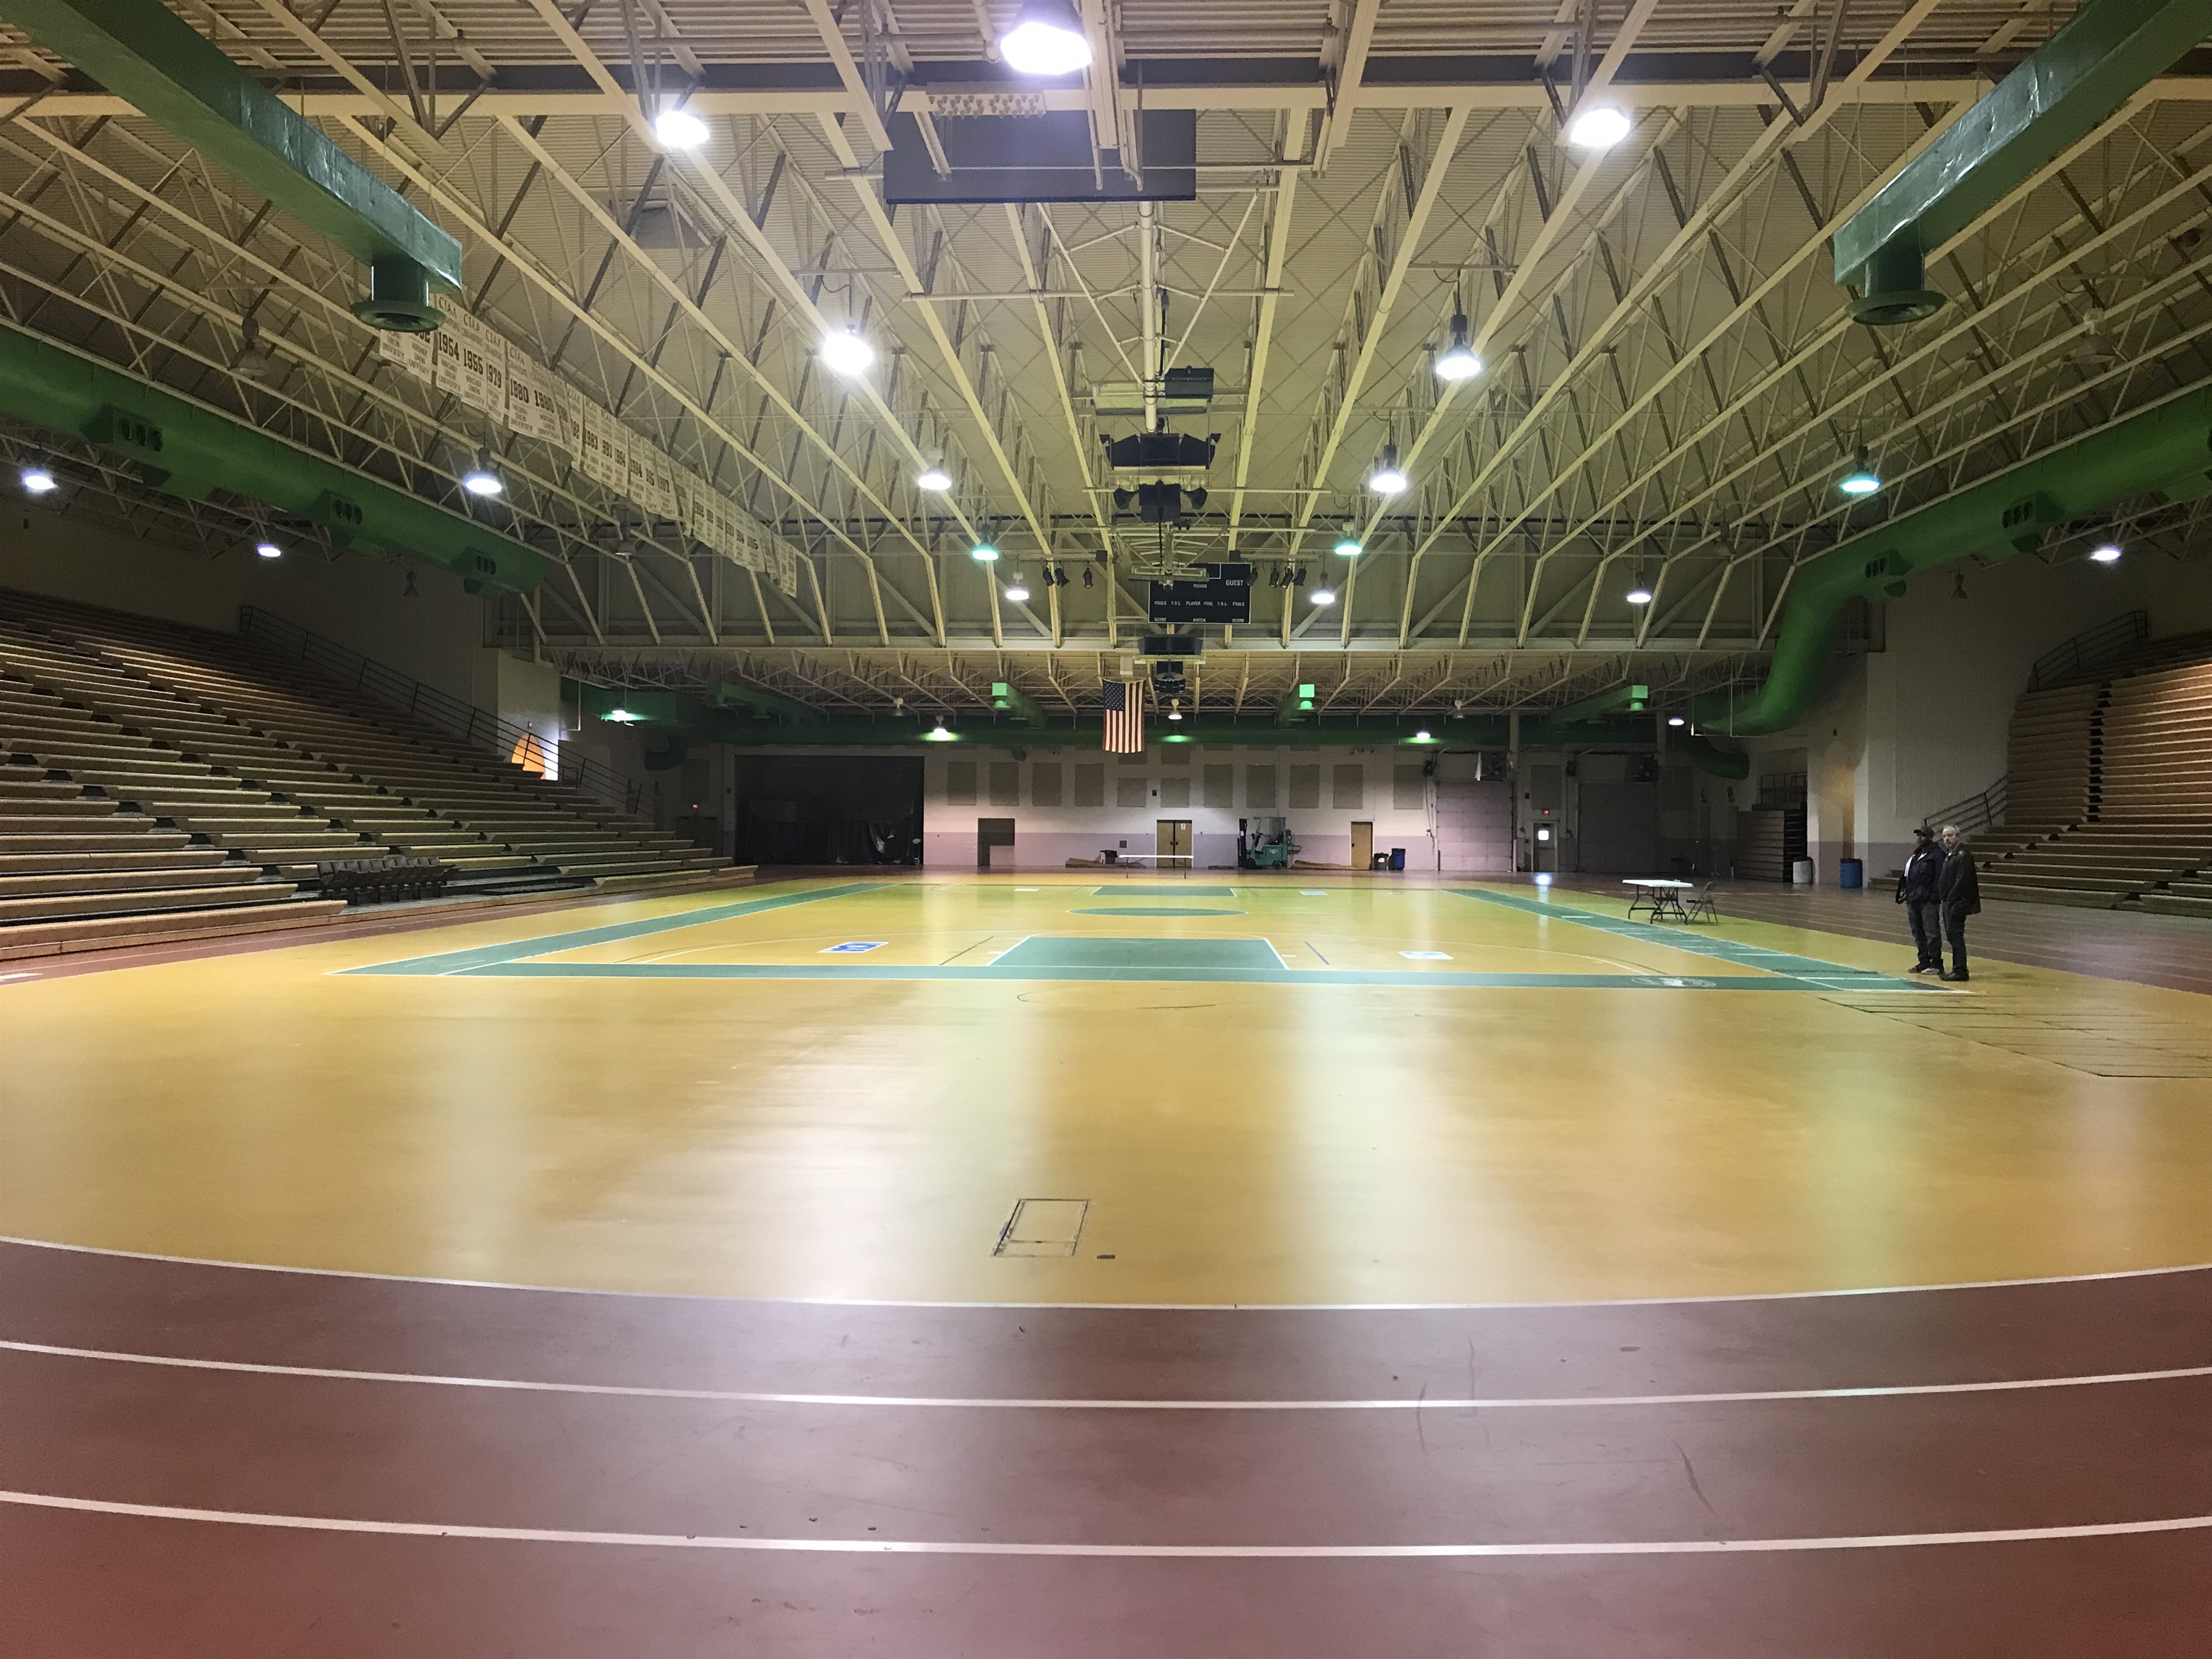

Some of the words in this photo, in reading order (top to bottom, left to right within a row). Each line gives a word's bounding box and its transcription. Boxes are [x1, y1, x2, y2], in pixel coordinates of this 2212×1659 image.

[439, 296, 457, 319] CIAA
[439, 331, 459, 362] 1954
[510, 347, 525, 365] CIAA
[464, 348, 483, 375] 1955
[486, 362, 501, 388] 1979
[510, 378, 529, 404] 1980
[534, 389, 554, 414] 1980
